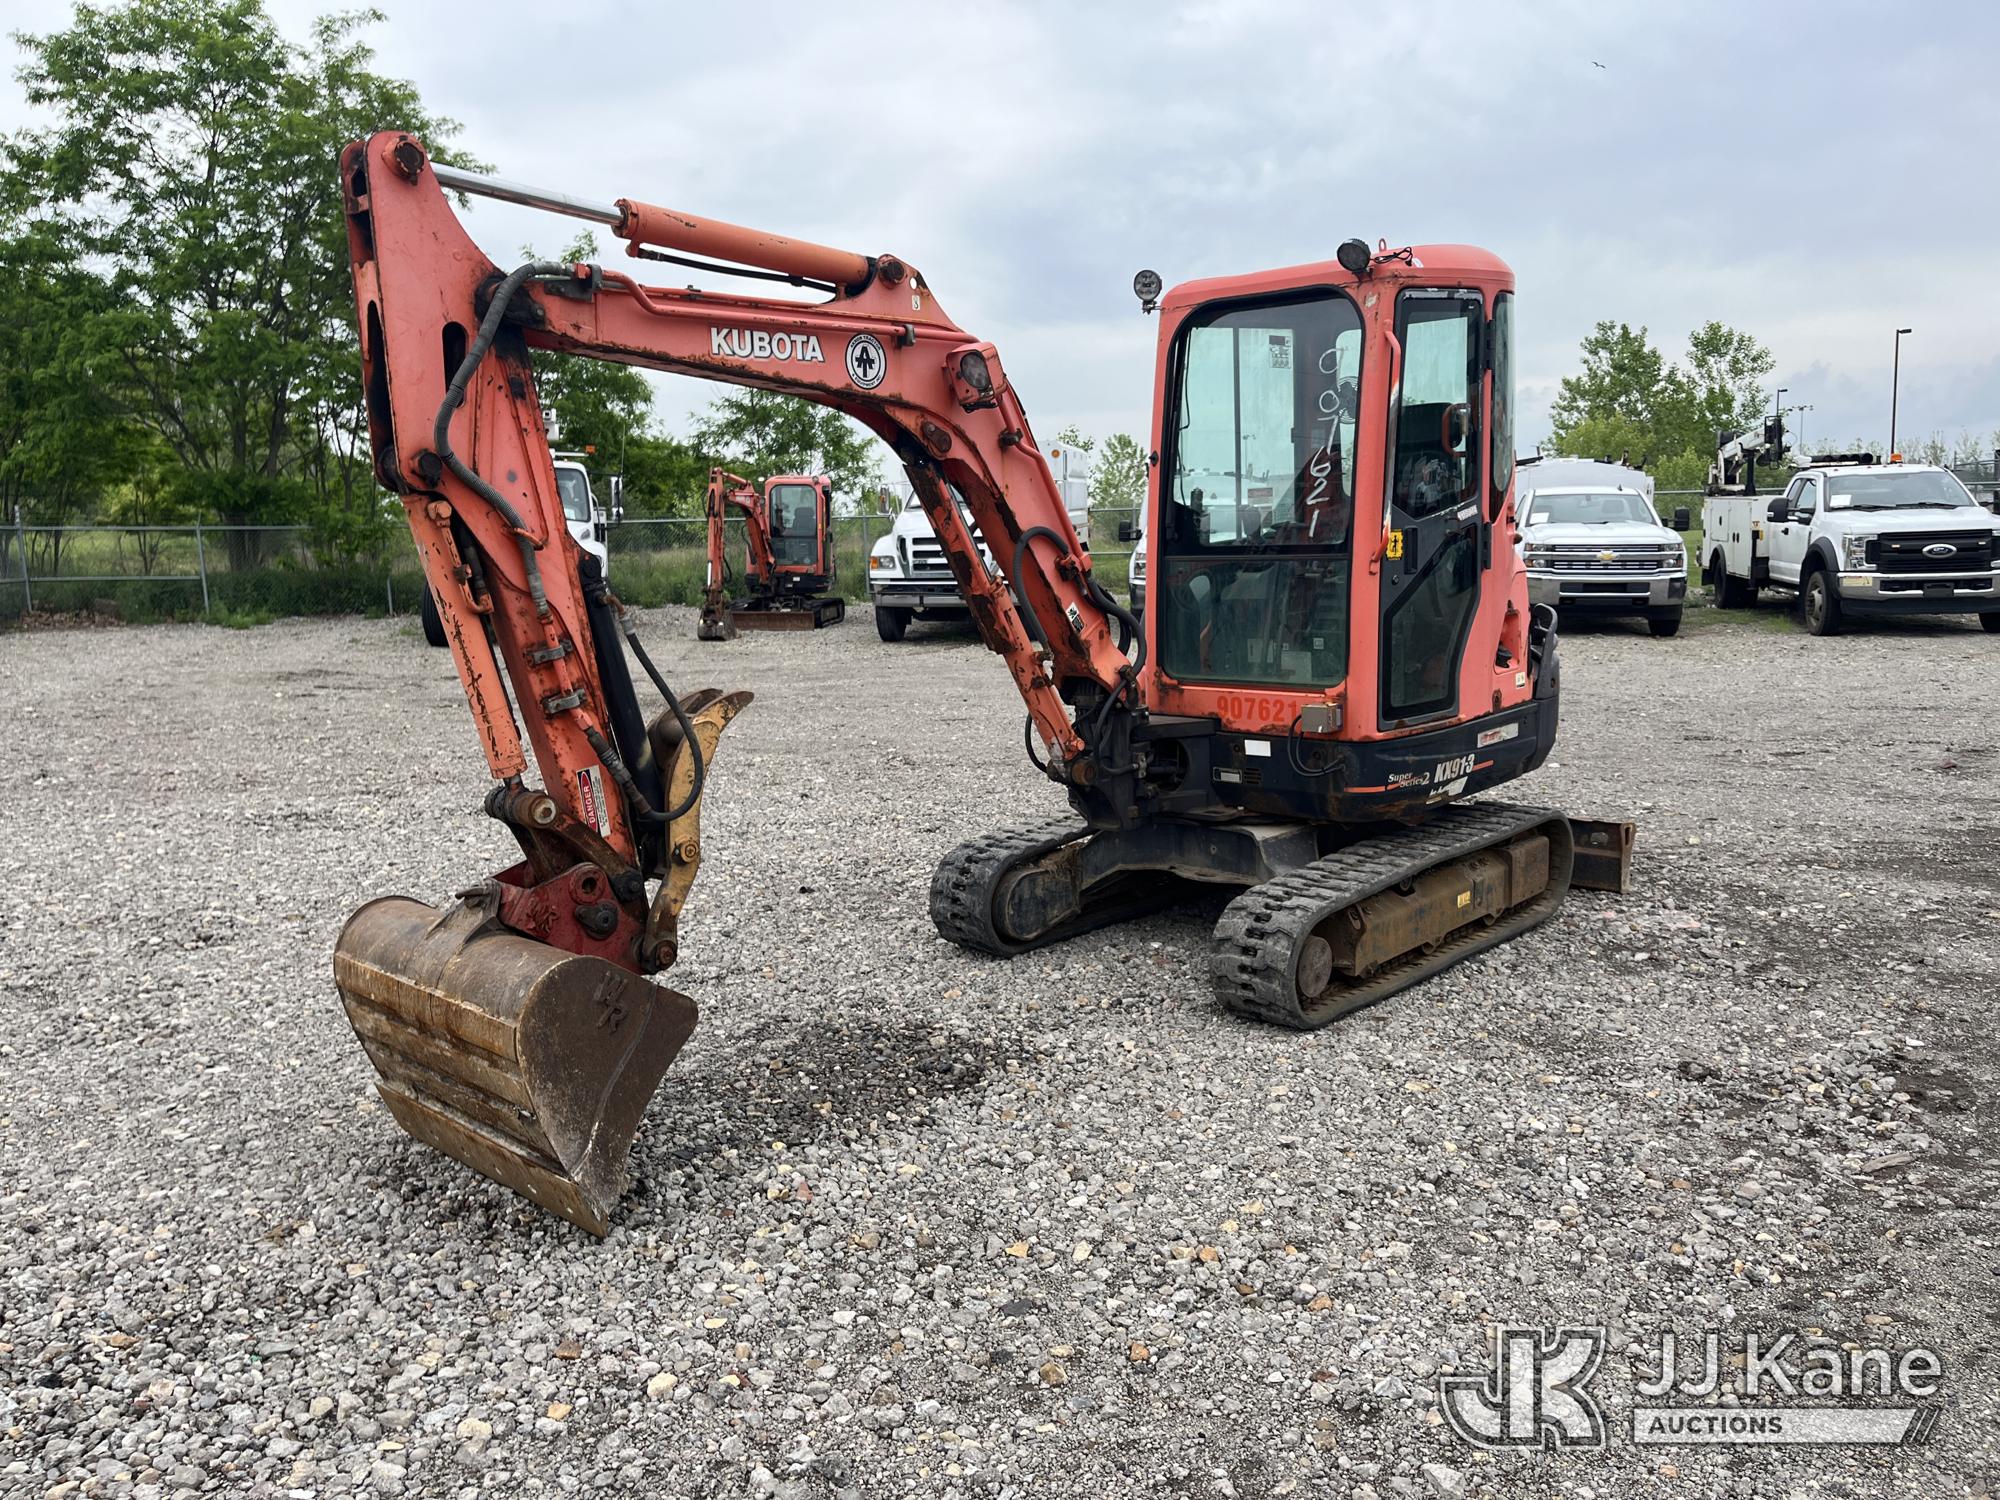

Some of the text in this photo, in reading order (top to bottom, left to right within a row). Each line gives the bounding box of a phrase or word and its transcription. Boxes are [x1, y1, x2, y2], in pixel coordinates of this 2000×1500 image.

[710, 327, 825, 362] KUBOTA
[1216, 696, 1297, 722] 907621
[1388, 772, 1413, 783] Super
[1434, 753, 1475, 784] KX91-3
[583, 785, 596, 824] DANGER
